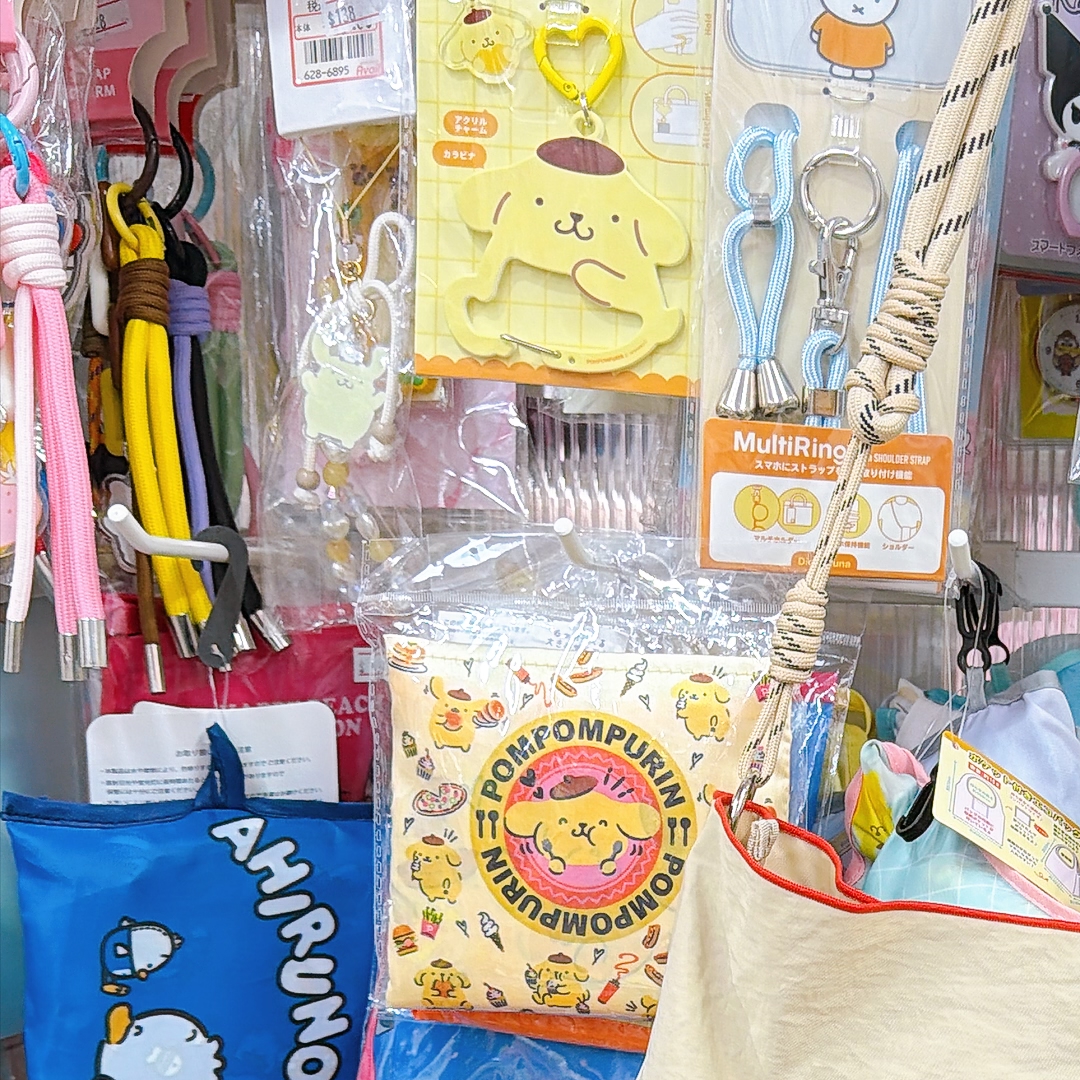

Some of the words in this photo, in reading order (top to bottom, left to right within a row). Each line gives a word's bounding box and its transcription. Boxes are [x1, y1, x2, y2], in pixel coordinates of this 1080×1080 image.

[327, 5, 356, 26] $138
[304, 66, 350, 80] 628-6895
[873, 453, 910, 465] SHOULDER
[910, 455, 931, 467] STRAP
[481, 717, 686, 808] POMPOMPURIN
[481, 846, 686, 937] POMPOMPURIN
